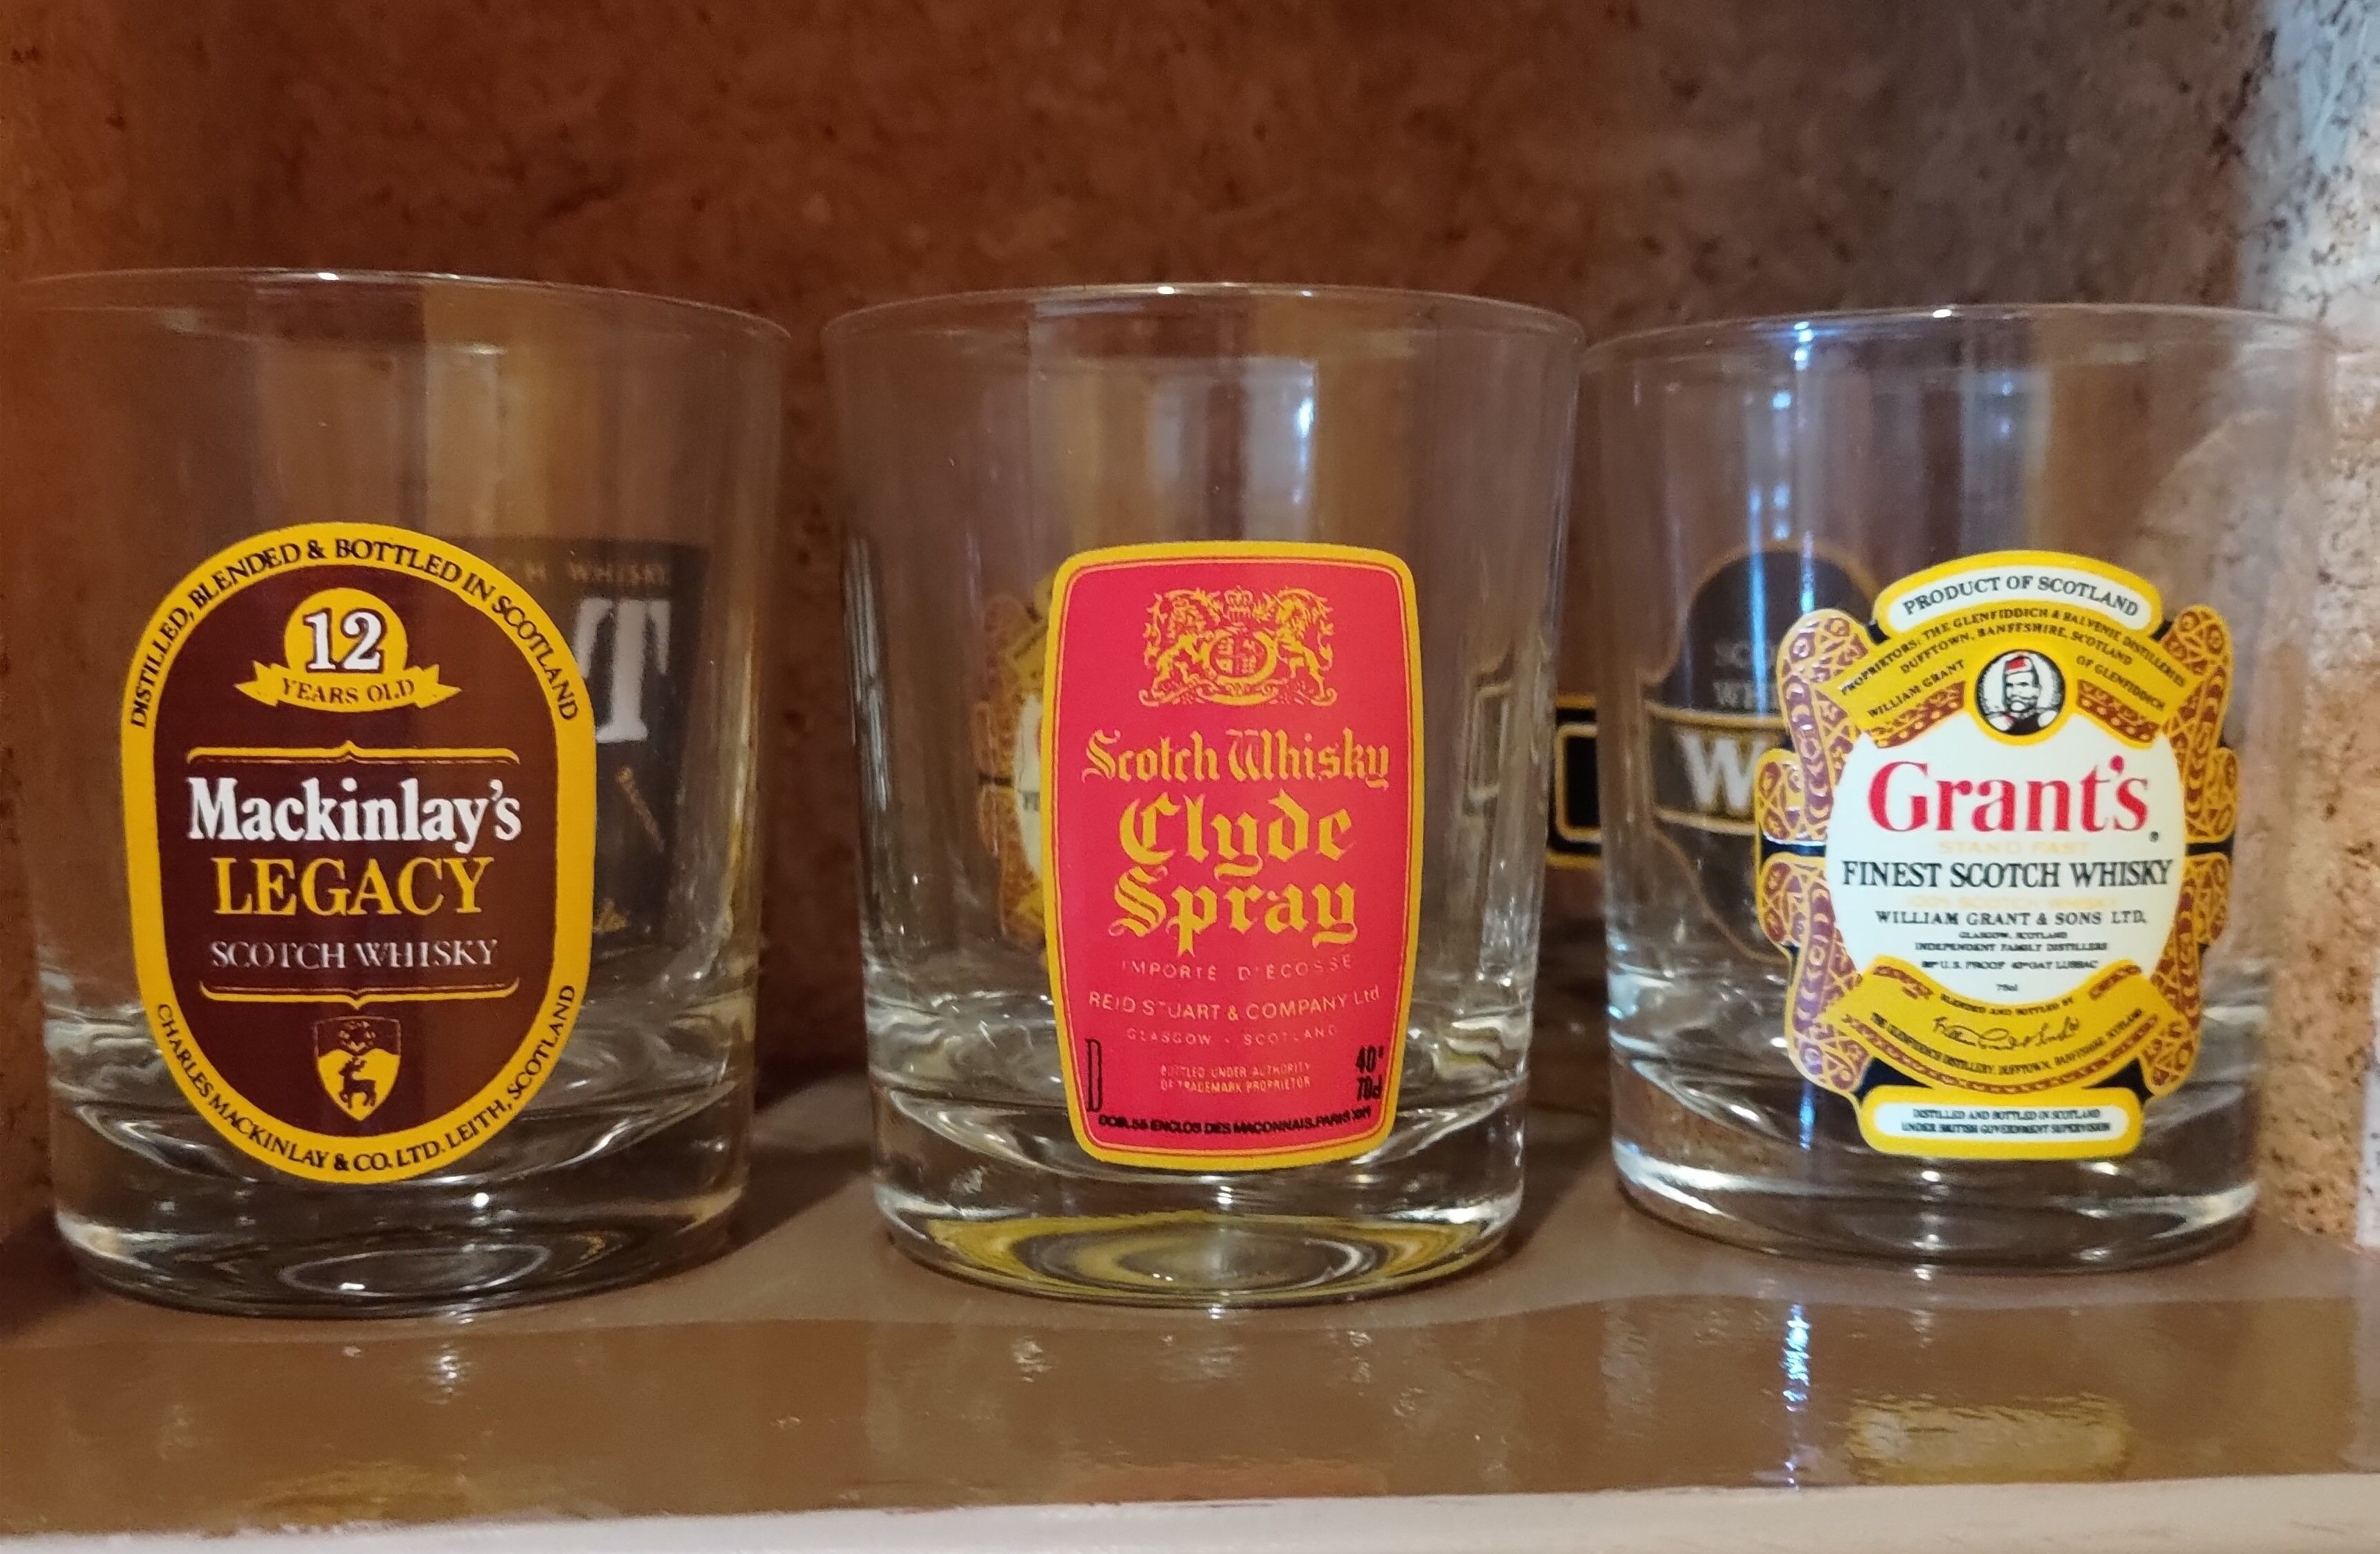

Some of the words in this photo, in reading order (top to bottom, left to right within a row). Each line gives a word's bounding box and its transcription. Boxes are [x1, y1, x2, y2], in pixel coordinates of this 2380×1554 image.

[1903, 576, 2001, 615] PRODUCT
[2006, 576, 2033, 589] OF
[2037, 576, 2138, 616] SCOTLAND
[1922, 623, 1951, 640] THE
[1953, 607, 2048, 627] GLENFIDDICH
[2064, 611, 2121, 641] BALVENIE
[131, 607, 195, 727] DISTILLED,
[188, 543, 301, 611] BLENDED
[307, 539, 327, 560] &
[335, 539, 463, 582] BOTTLED
[460, 572, 497, 602] IN
[492, 595, 579, 720] SCOTLAND
[303, 607, 386, 673] 12
[2071, 631, 2132, 666] SCOTLAND
[283, 677, 359, 705] YEARS
[367, 678, 415, 703] OLD
[1868, 684, 1922, 717] WILLIAM
[1922, 659, 1964, 687] GRANT
[2076, 655, 2094, 667] OF
[2095, 664, 2166, 711] GLENFIDDICH
[1081, 728, 1221, 784] Scotch
[1225, 727, 1389, 791] Whisky
[187, 777, 522, 854] Mackinlay's
[1868, 755, 2148, 832] Grant's
[1119, 788, 1356, 884] Clyde
[211, 856, 494, 916] LEGACY
[1842, 860, 1942, 888] FINEST
[1950, 862, 2061, 888] SCOTCH
[2069, 859, 2173, 888] WHISKY
[1108, 865, 1358, 958] Spray
[1876, 910, 1958, 926] WILLIAM
[1966, 912, 2030, 926] GRANT
[2036, 913, 2047, 926] &
[2055, 912, 2102, 926] SONS
[210, 940, 346, 969] SCOTCH
[354, 939, 498, 968] WHISKY
[1089, 991, 1136, 1013] REID
[1142, 999, 1221, 1020] STUART
[1227, 1005, 1239, 1021] &
[1246, 994, 1348, 1020] COMPANY
[1353, 984, 1380, 1005] Ltd
[1126, 1027, 1212, 1046] GLASGOW
[157, 1003, 214, 1098] CHARLES
[208, 1092, 329, 1168] MACKINLAY
[334, 1153, 350, 1171] &
[397, 1141, 445, 1167] LTD.
[445, 1099, 512, 1148] LEITH,
[507, 985, 575, 1100] SCOTLAND
